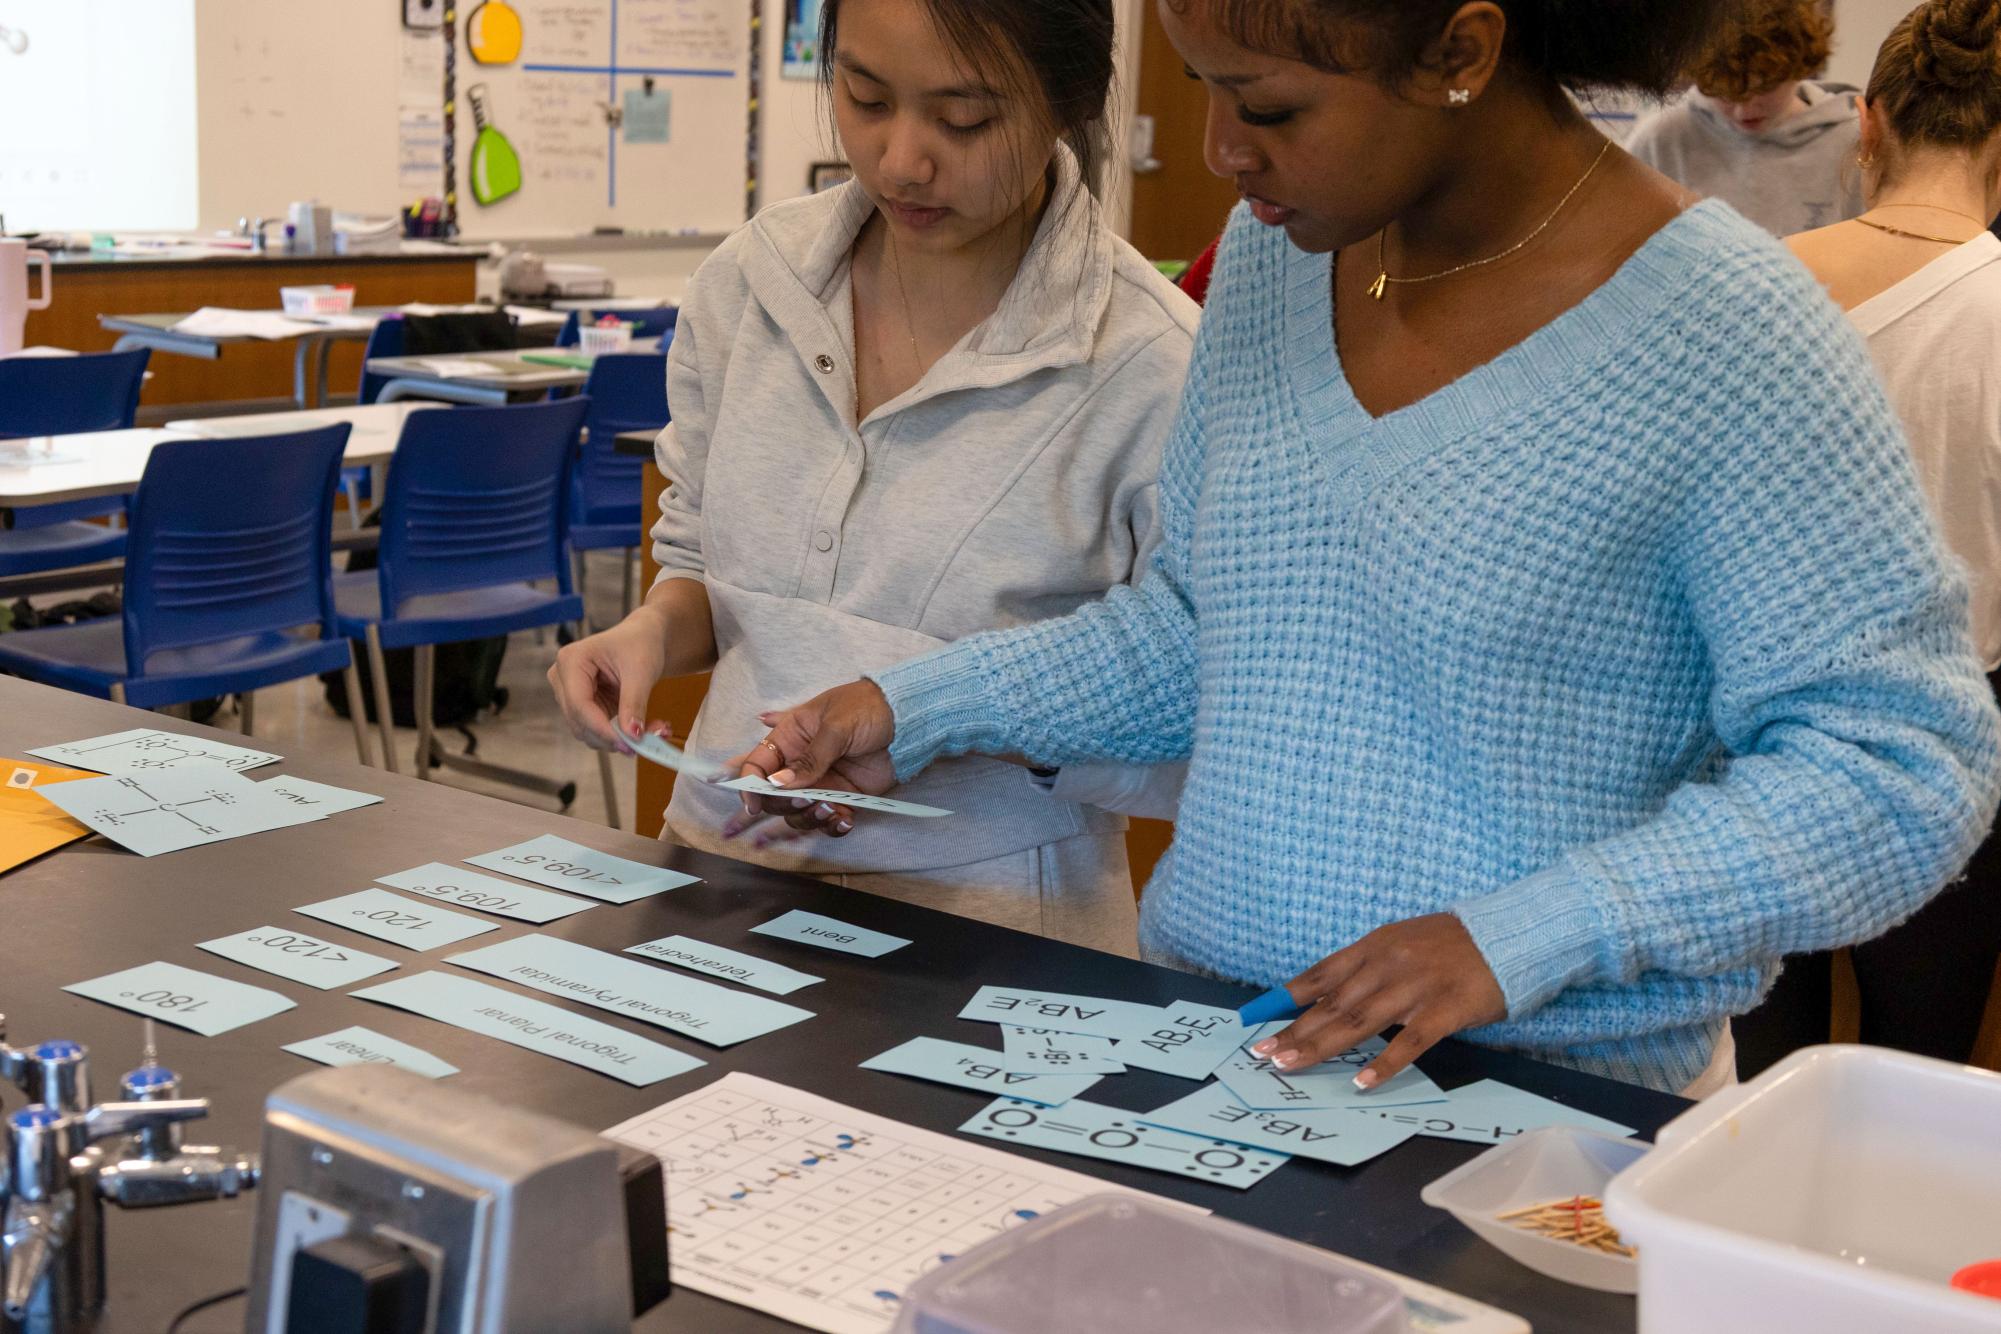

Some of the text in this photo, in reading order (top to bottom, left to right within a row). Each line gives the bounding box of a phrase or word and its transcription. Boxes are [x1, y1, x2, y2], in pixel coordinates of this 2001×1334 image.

[800, 926, 857, 945] Bent
[636, 943, 756, 982] Tetrahedral
[509, 965, 712, 1030] Trigonal Pyramidal
[473, 1006, 637, 1066] Trigonal Planar
